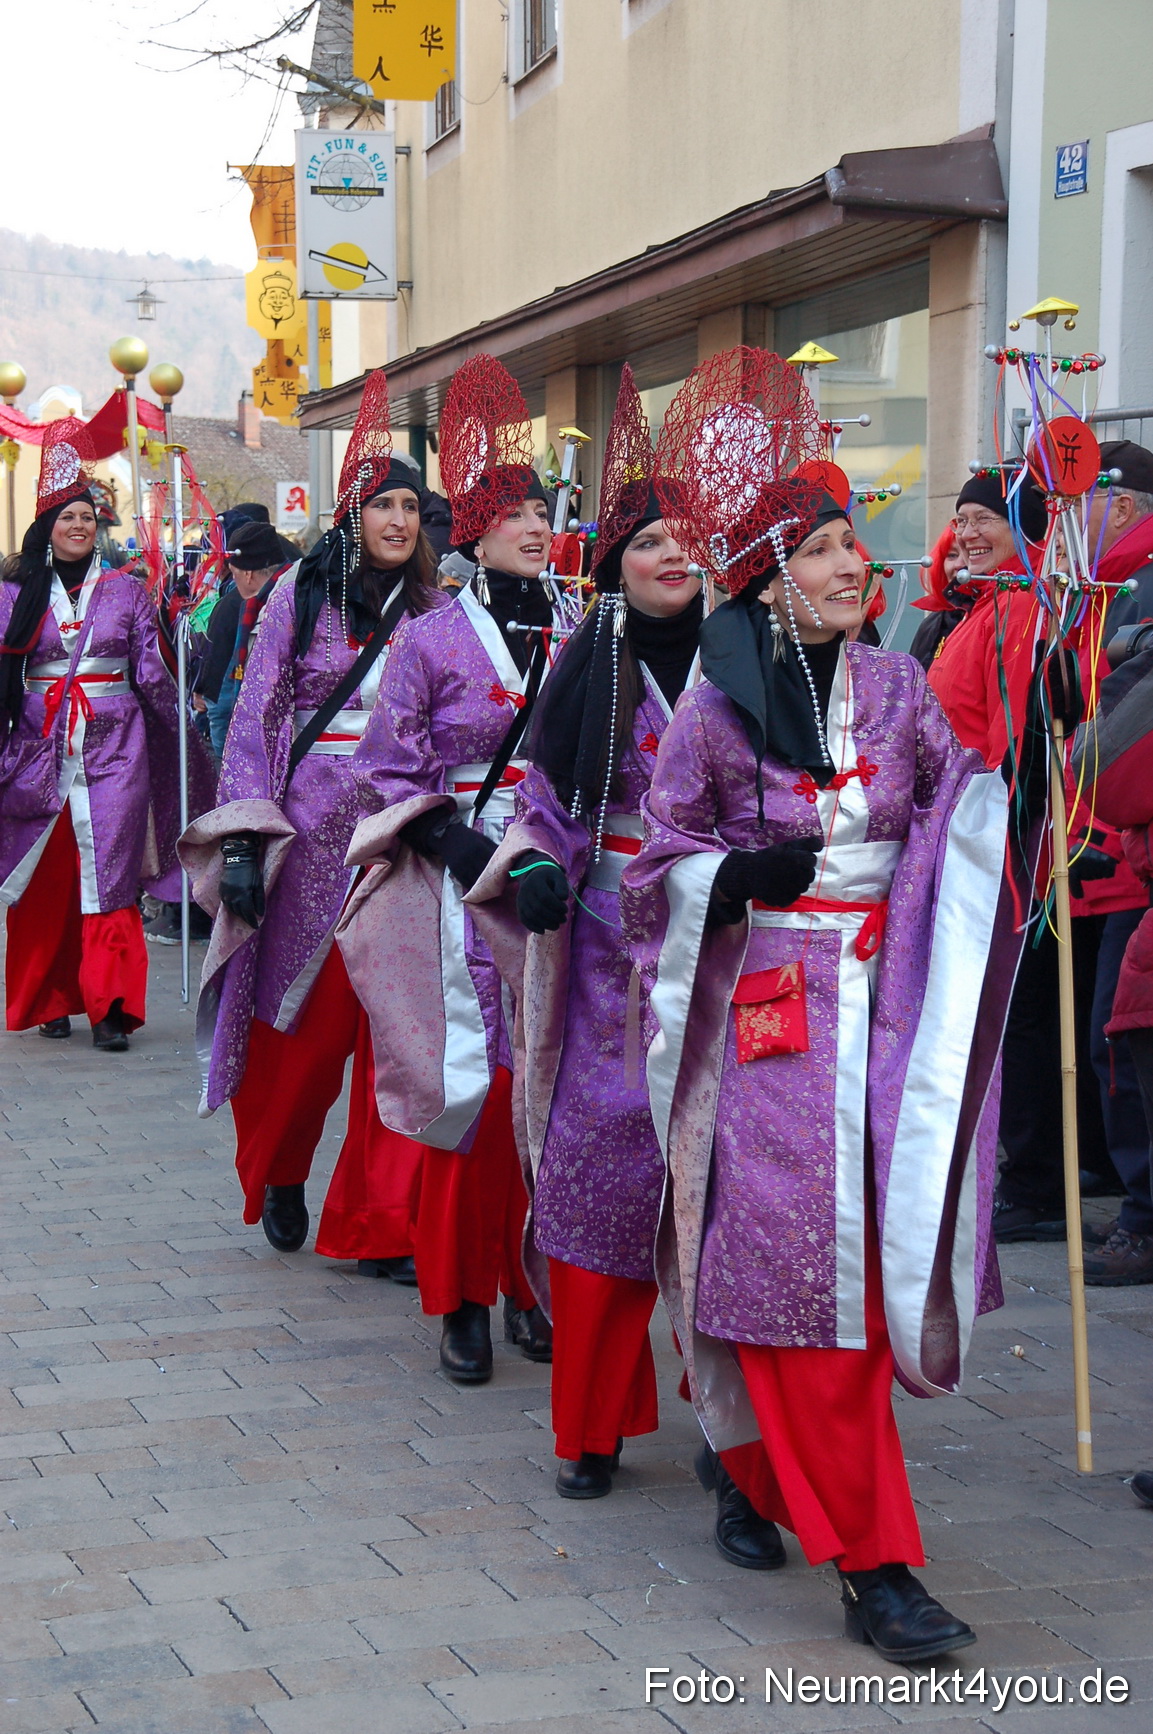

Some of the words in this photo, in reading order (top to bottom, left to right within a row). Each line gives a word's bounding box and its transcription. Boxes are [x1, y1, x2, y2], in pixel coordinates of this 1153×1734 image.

[420, 25, 444, 57] 华
[369, 56, 391, 81] 人
[306, 155, 321, 180] FIT
[325, 138, 354, 153] FUN
[357, 143, 367, 155] &
[369, 152, 388, 182] SUN
[1060, 144, 1083, 174] 42
[260, 391, 274, 409] 人
[280, 380, 297, 401] 华
